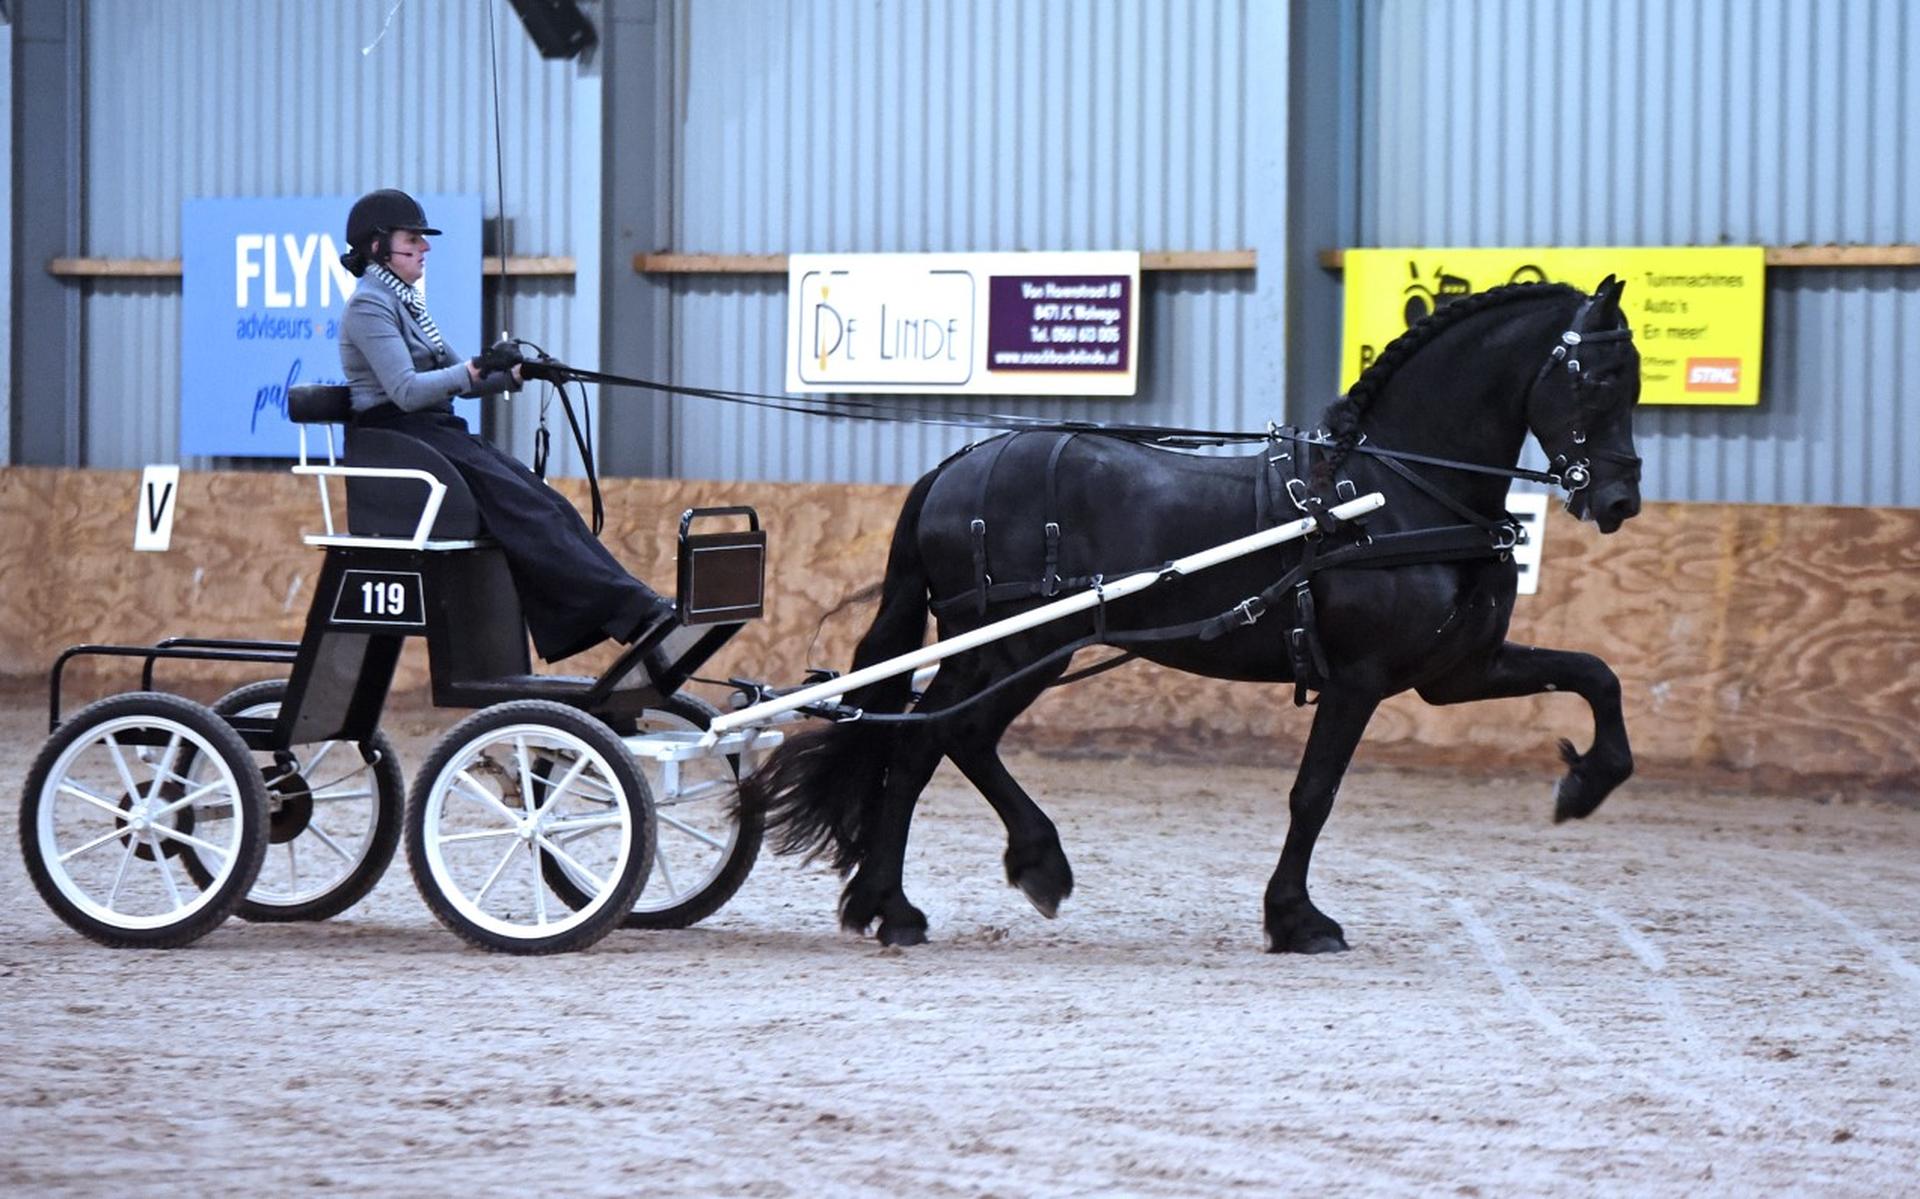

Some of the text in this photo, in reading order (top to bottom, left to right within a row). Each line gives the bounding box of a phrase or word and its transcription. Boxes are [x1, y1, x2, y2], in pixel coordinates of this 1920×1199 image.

[235, 233, 358, 308] FLYN
[1645, 271, 1744, 288] Tuinmachines
[1643, 298, 1688, 313] Auto's
[236, 314, 313, 340] adviseurs
[814, 303, 958, 361] DE LINDE
[1643, 323, 1661, 340] En
[1690, 366, 1737, 384] STIHL
[147, 482, 173, 534] V
[361, 581, 405, 615] 119
